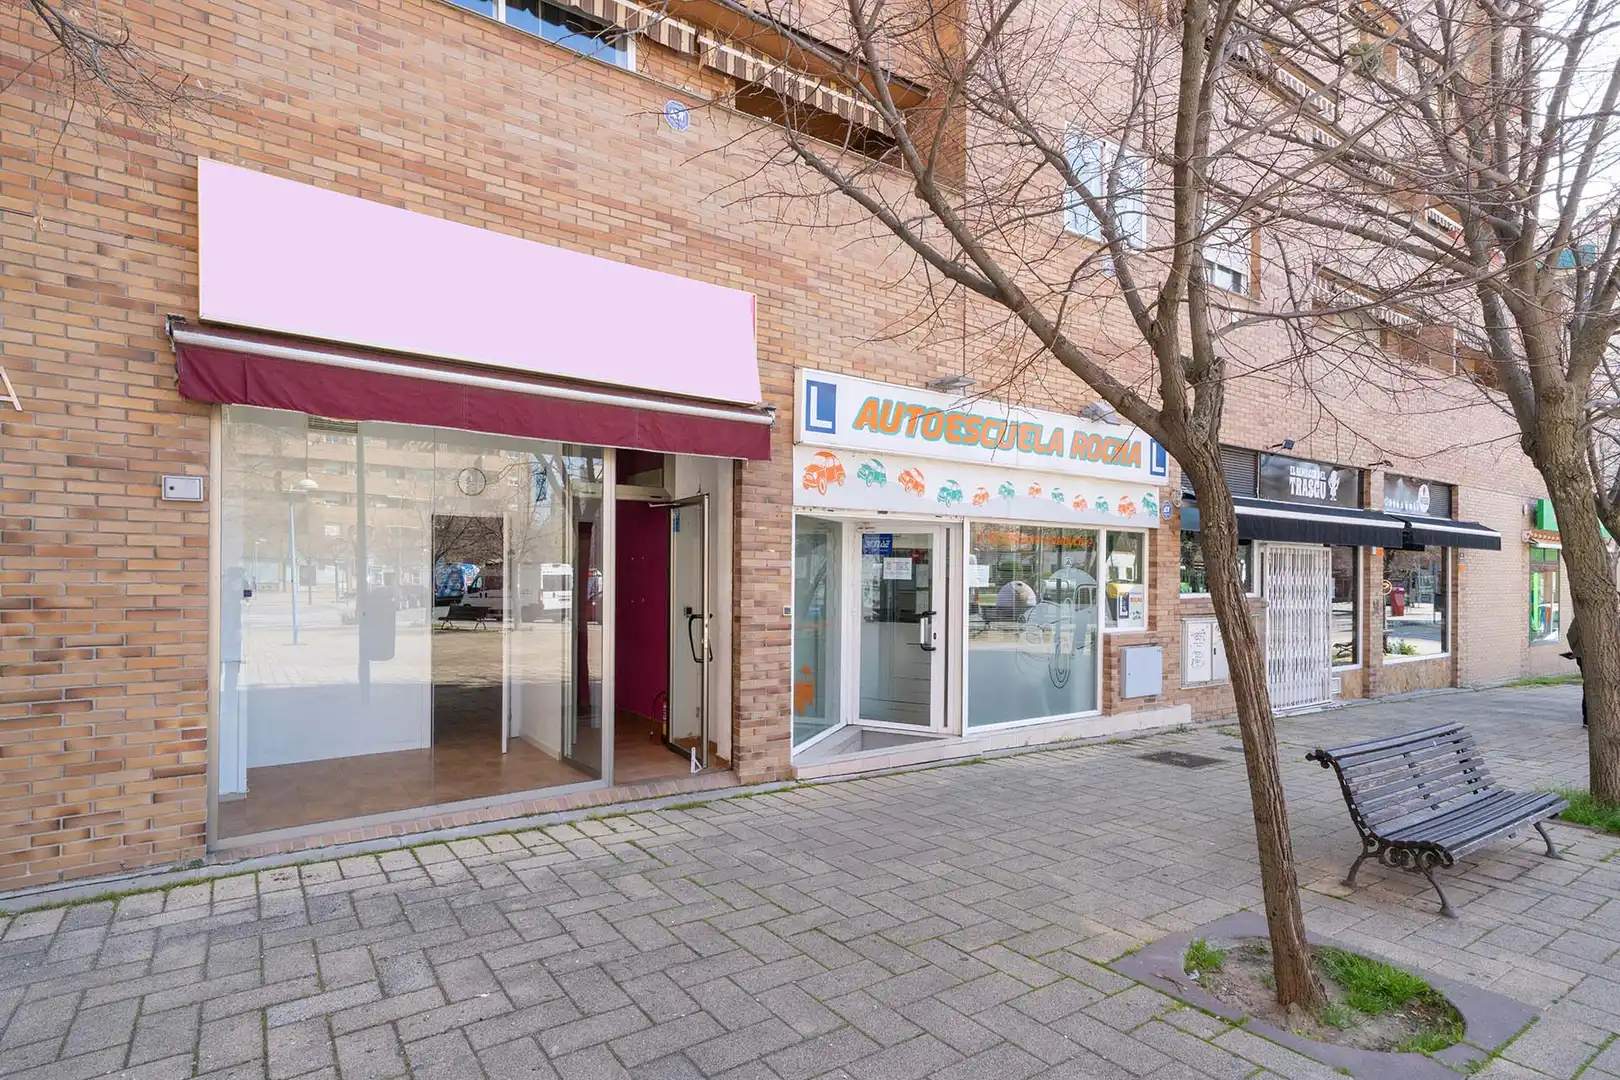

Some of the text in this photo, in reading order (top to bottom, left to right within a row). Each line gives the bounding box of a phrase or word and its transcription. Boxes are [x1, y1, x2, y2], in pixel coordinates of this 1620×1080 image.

[809, 385, 833, 430] L
[852, 396, 1141, 468] AUTOESCUELA ROCHA
[1151, 442, 1165, 473] L
[1289, 476, 1327, 500] TRASGU
